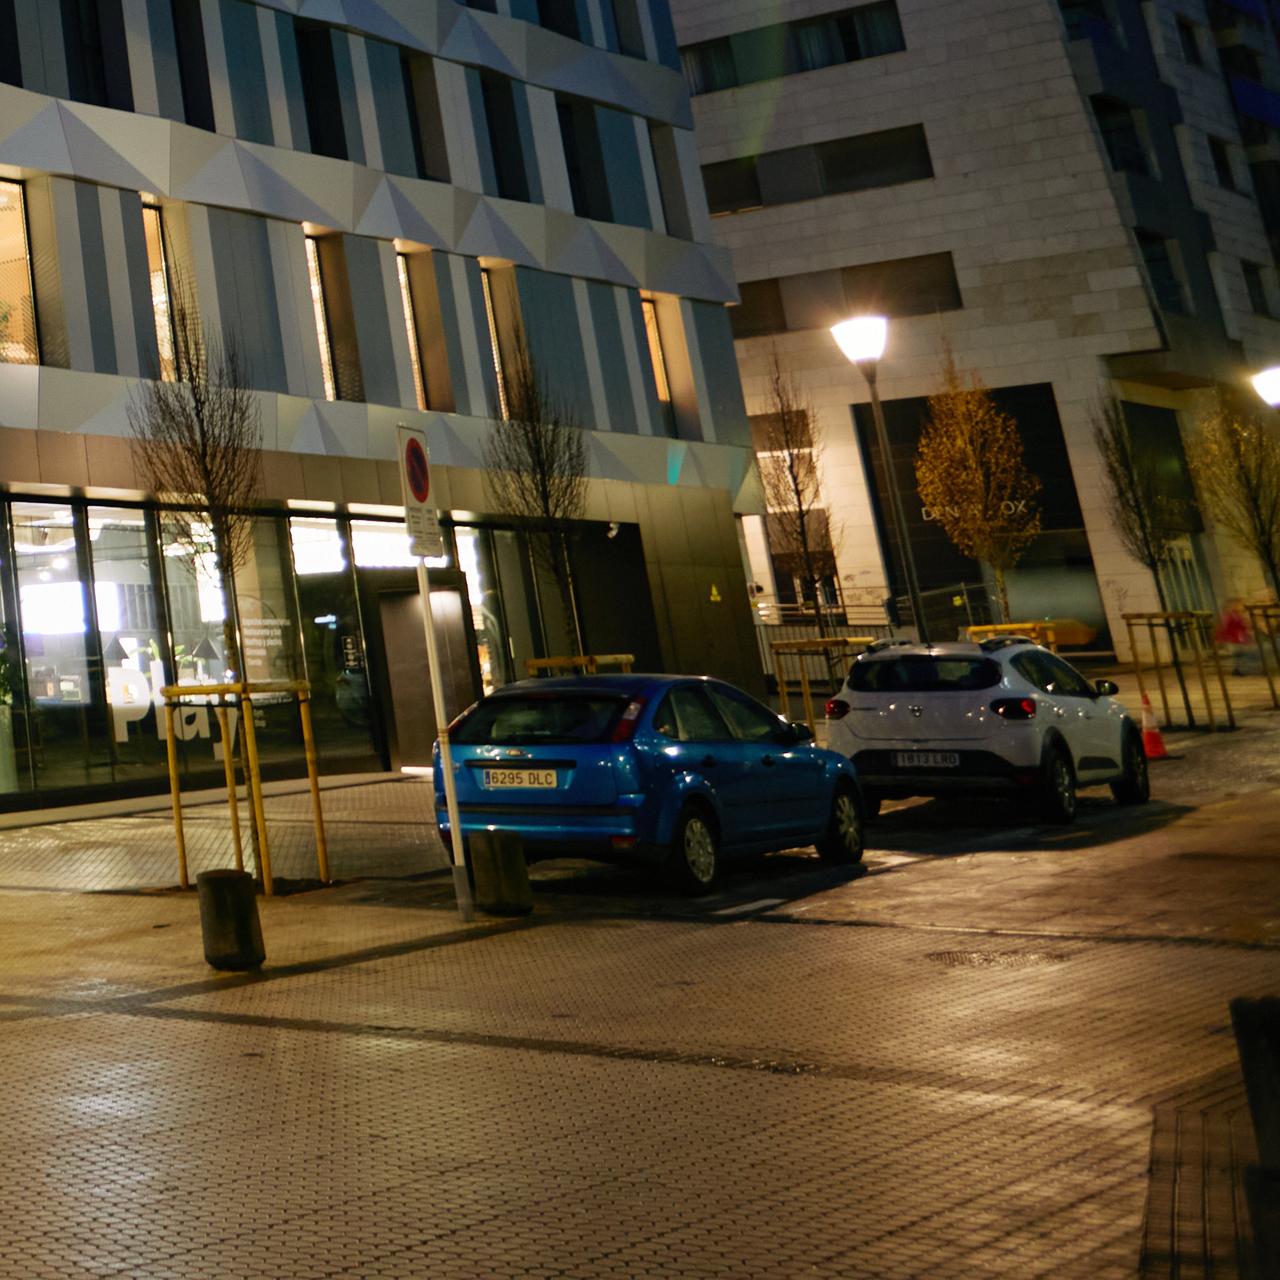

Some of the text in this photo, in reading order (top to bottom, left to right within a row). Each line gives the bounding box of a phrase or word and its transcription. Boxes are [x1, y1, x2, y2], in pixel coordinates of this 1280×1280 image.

[107, 660, 239, 761] Play
[491, 771, 553, 785] 6295 DLC
